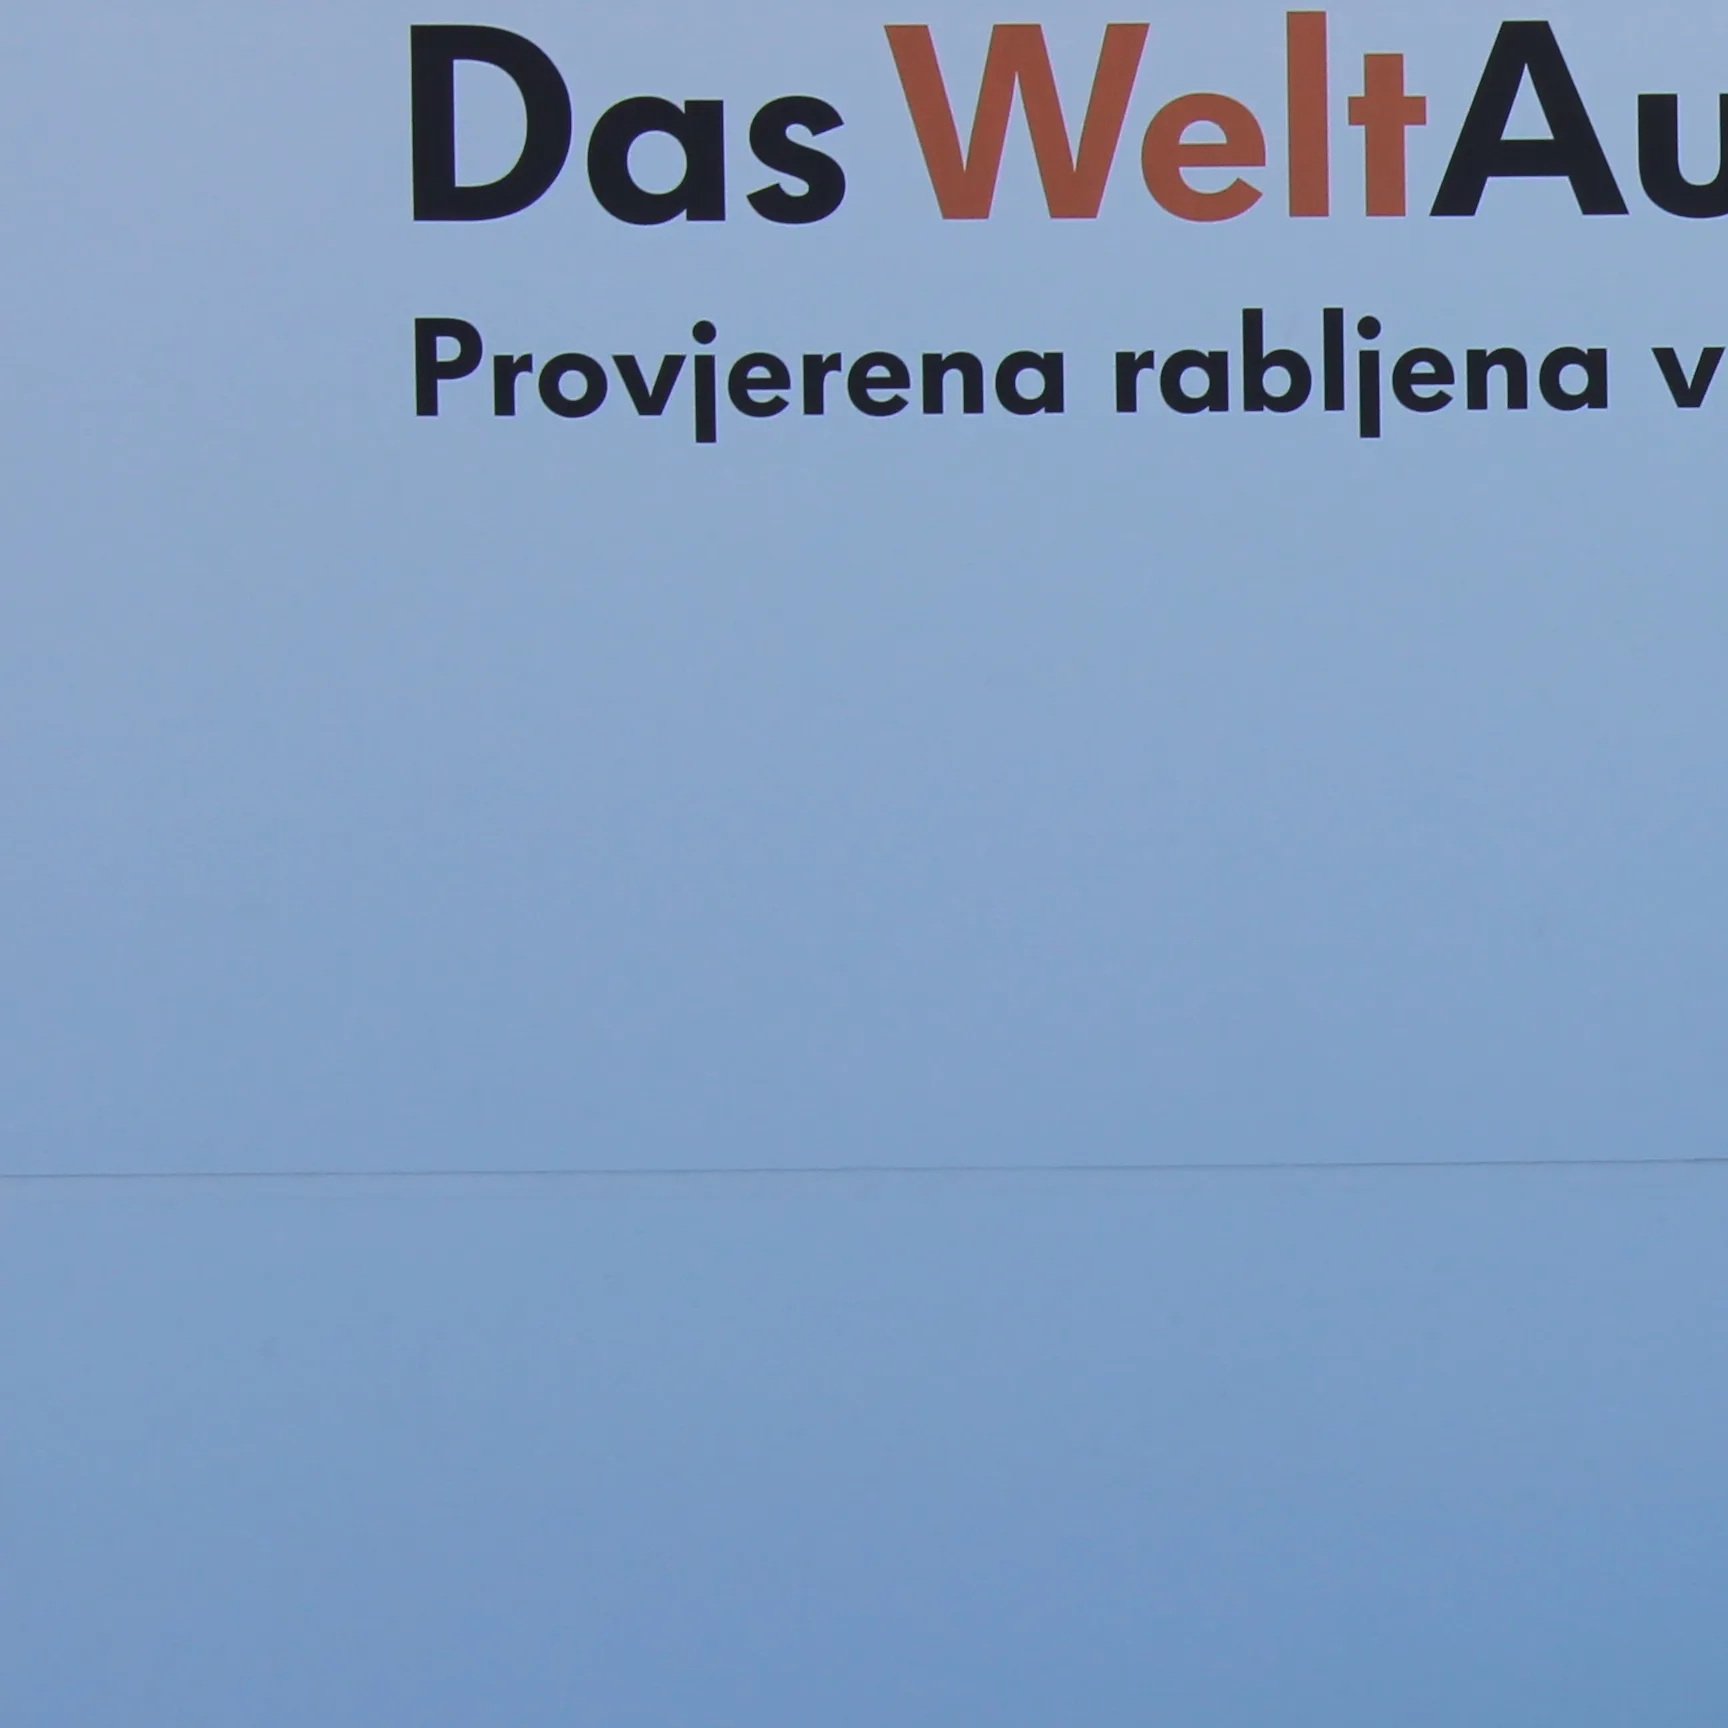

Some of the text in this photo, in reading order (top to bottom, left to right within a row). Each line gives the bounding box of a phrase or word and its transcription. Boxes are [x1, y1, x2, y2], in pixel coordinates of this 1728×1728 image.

[410, 23, 847, 225] Das
[413, 317, 1065, 444] Provjerena
[1114, 306, 1609, 439] rabljena
